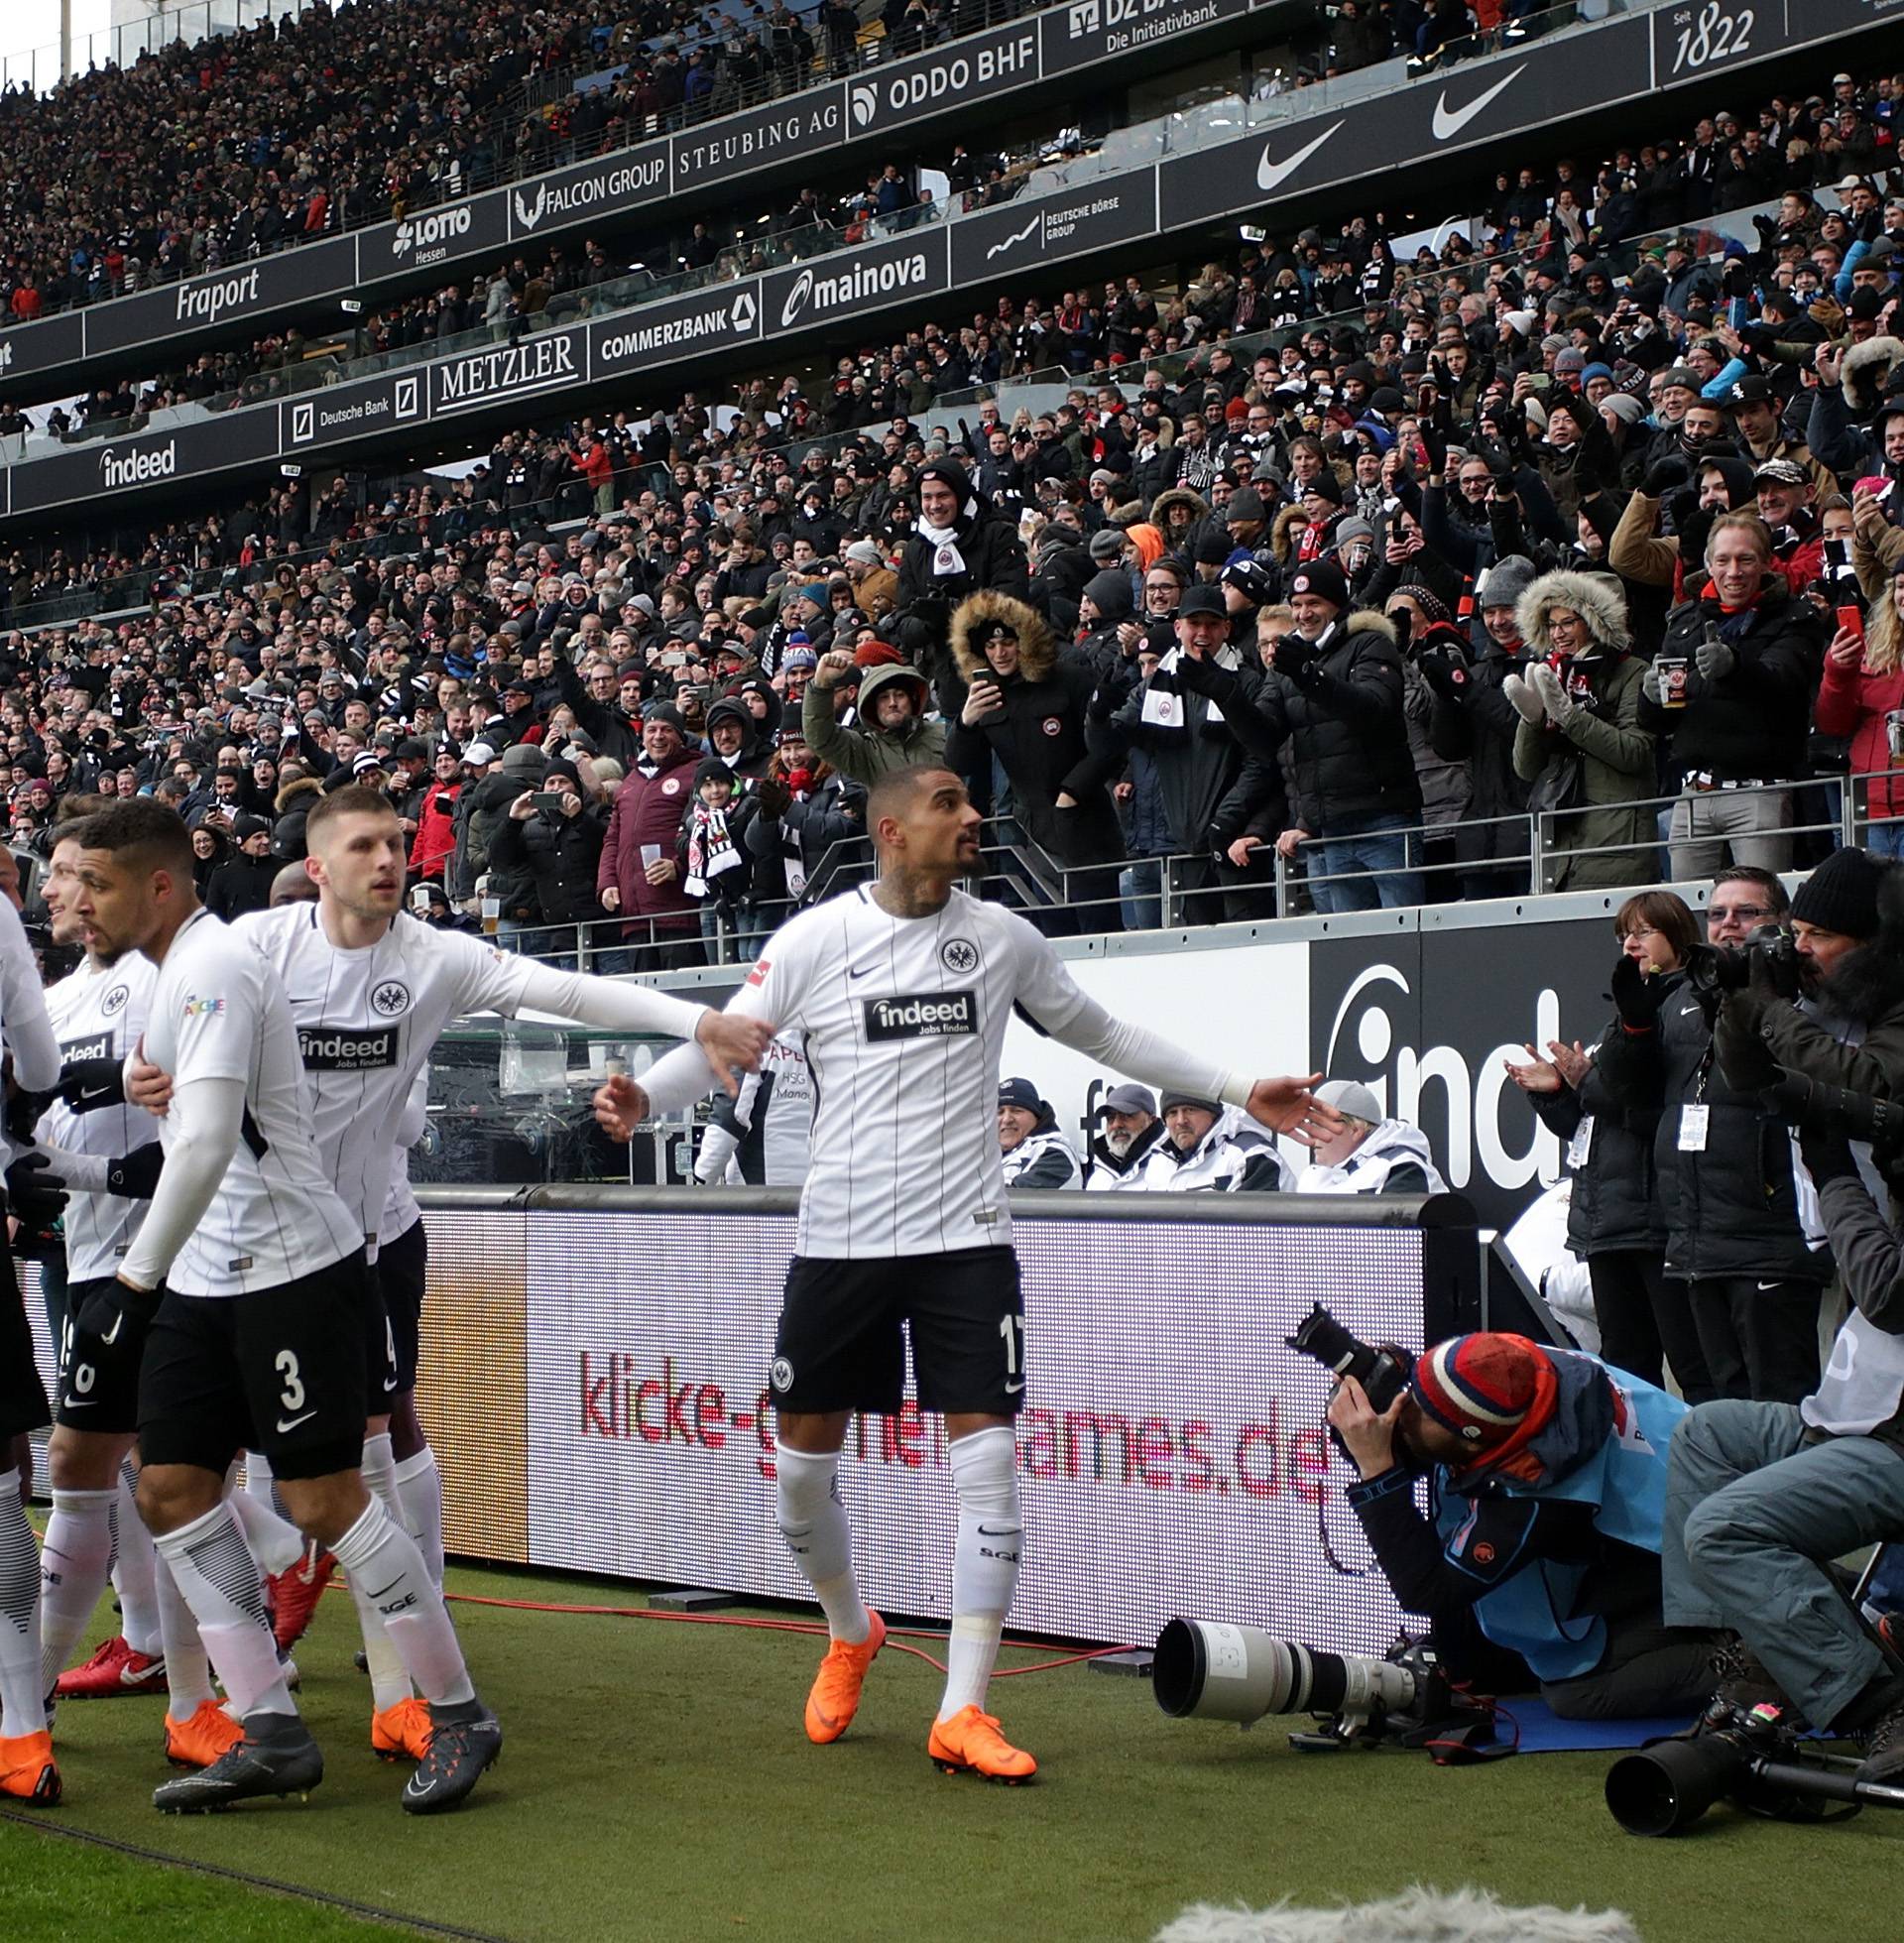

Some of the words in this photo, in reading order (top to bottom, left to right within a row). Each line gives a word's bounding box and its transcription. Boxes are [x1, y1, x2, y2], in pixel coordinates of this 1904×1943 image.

[1106, 32, 1129, 53] Die
[1131, 1, 1218, 45] Initiativbank
[1672, 1, 1754, 73] 1822
[1673, 11, 1692, 26] Seit
[890, 59, 970, 109] ODDO
[978, 36, 1034, 82] BHF
[680, 117, 801, 174] STEUBING
[809, 105, 838, 134] AG
[546, 178, 606, 214] FALCON
[608, 159, 664, 196] GROUP
[416, 207, 470, 246] LOTTO
[1046, 205, 1090, 226] DEUTSCHE
[1091, 197, 1120, 214] BÖRSE
[1046, 223, 1076, 240] GROUP
[416, 246, 446, 265] Hessen
[177, 268, 259, 321] Fraport
[813, 253, 926, 309] mainova
[601, 308, 727, 361] COMMERZBANK
[440, 335, 575, 401] METZLER
[320, 406, 363, 426] Deutsche
[365, 397, 389, 416] Bank
[100, 440, 176, 487] indeed
[873, 997, 968, 1028] indeed
[919, 1025, 940, 1034] Jobs
[943, 1023, 969, 1032] finden
[298, 1032, 388, 1057] indeed
[335, 1059, 357, 1068] Jobs
[359, 1058, 387, 1067] finden
[782, 1072, 805, 1085] HSG
[275, 1349, 305, 1410] 3
[980, 1547, 1019, 1564] SGE
